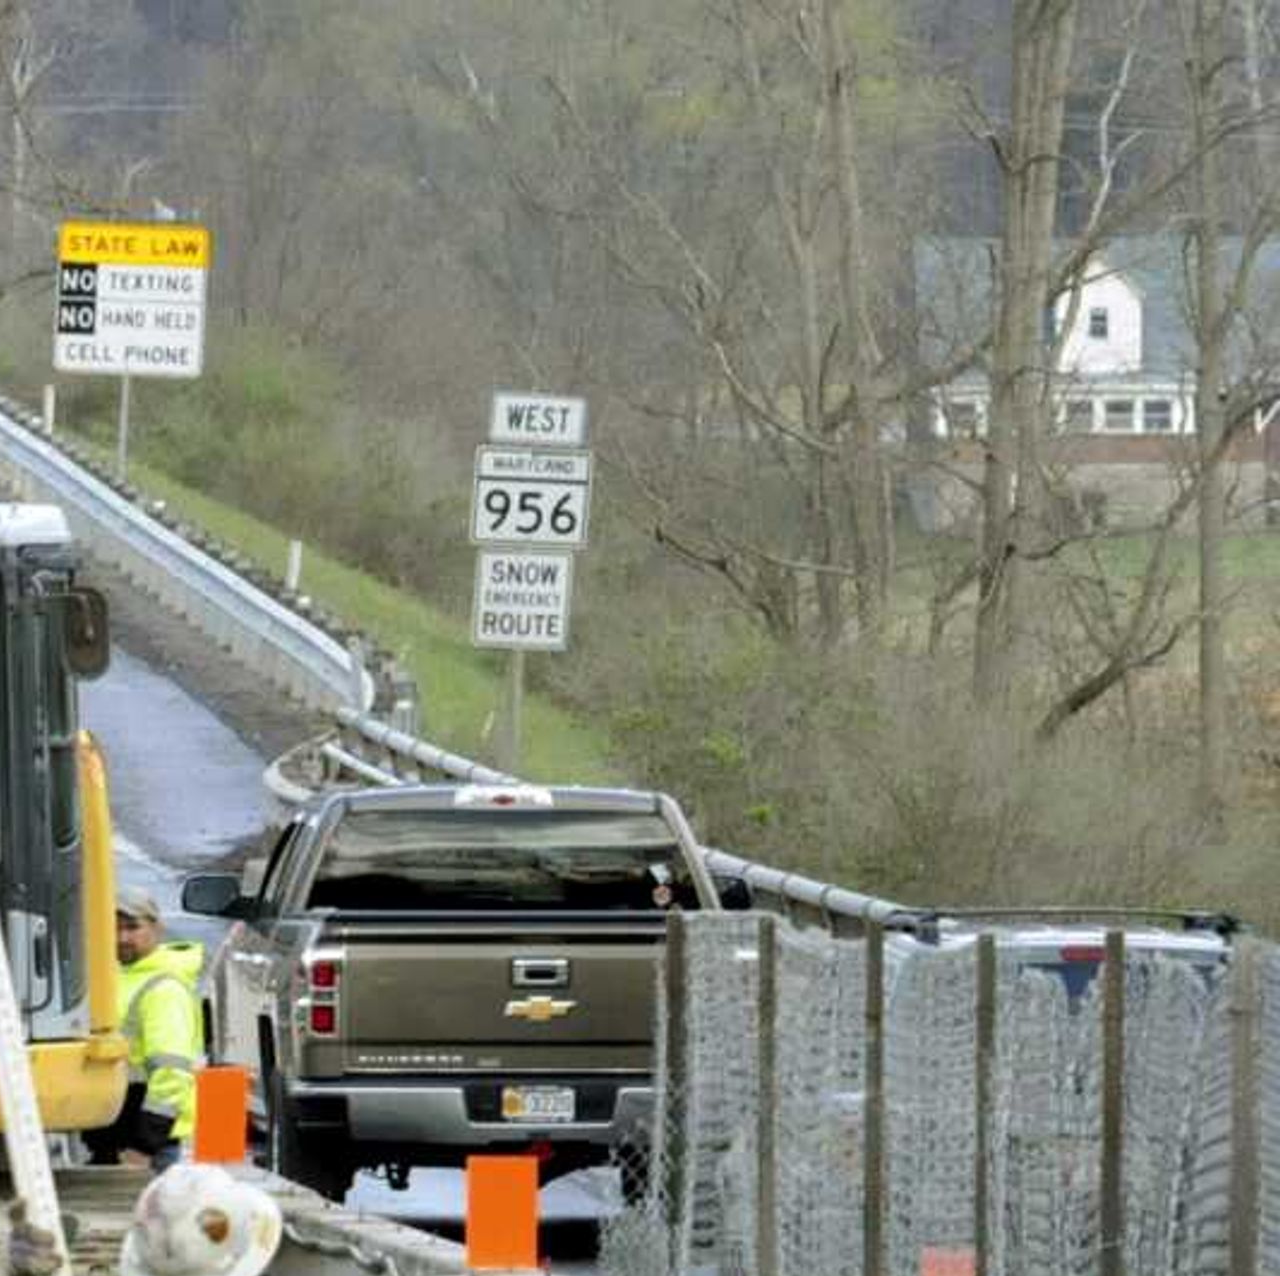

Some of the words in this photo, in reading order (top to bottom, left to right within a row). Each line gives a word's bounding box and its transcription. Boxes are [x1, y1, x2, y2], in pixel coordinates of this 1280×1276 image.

[68, 234, 138, 254] STATE
[149, 238, 200, 257] LAW
[61, 269, 96, 292] NO
[108, 272, 194, 293] TEXTING
[58, 305, 94, 329] NO
[101, 308, 146, 329] HAND
[154, 310, 196, 331] HELD
[64, 342, 114, 363] CELL
[124, 345, 190, 366] PHONE
[506, 403, 571, 434] WEST
[492, 455, 575, 475] MARYLAND
[483, 487, 578, 537] 956
[489, 559, 559, 586] SNOW
[484, 589, 561, 608] EMERGENCY
[481, 611, 560, 638] ROUTE
